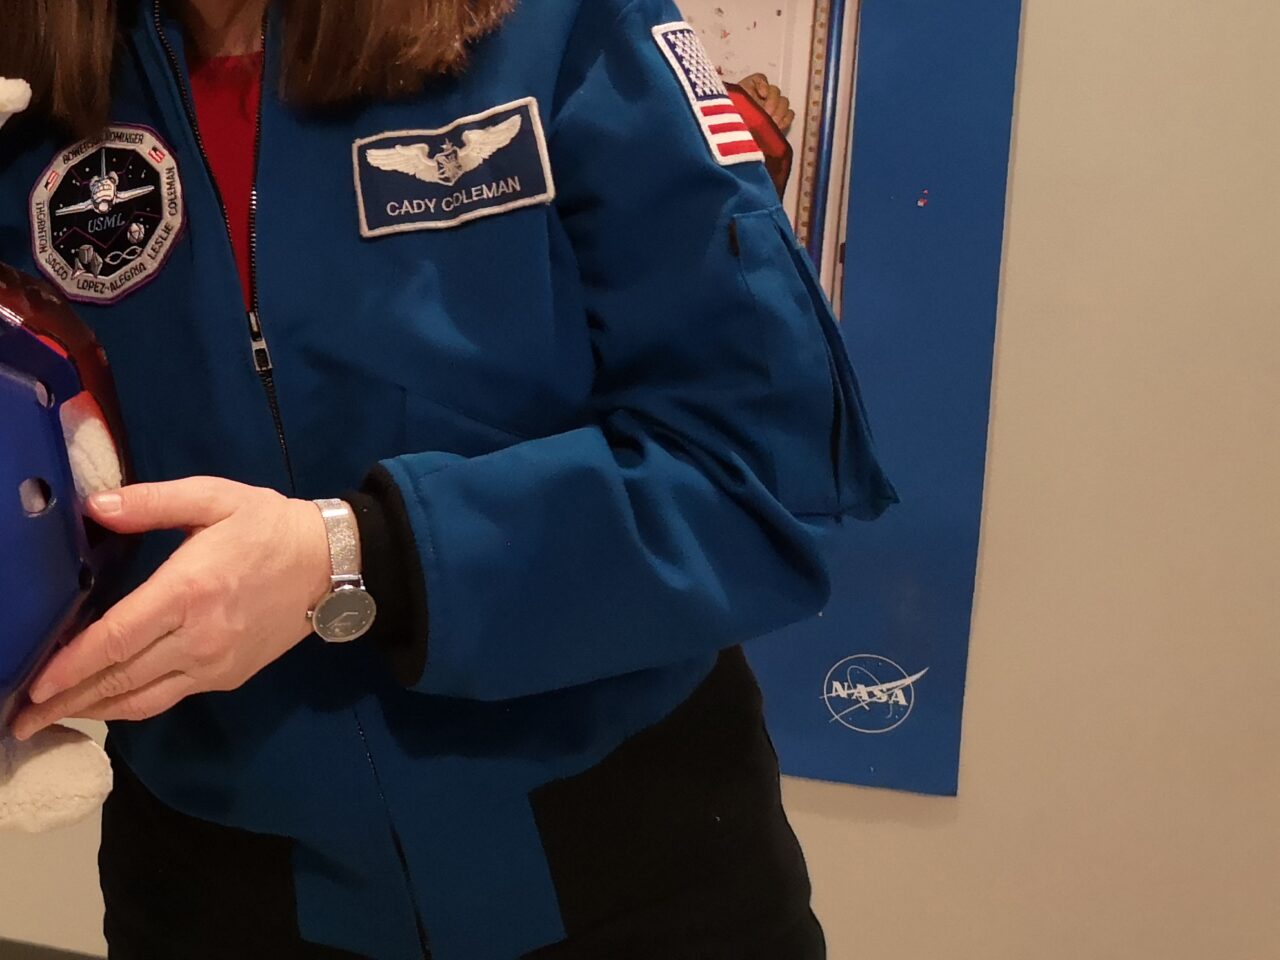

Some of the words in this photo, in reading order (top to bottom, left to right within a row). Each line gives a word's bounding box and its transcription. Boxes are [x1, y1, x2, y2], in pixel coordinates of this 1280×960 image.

[386, 198, 437, 216] CADY
[441, 176, 521, 212] COLEMAN
[831, 680, 908, 706] NASA
